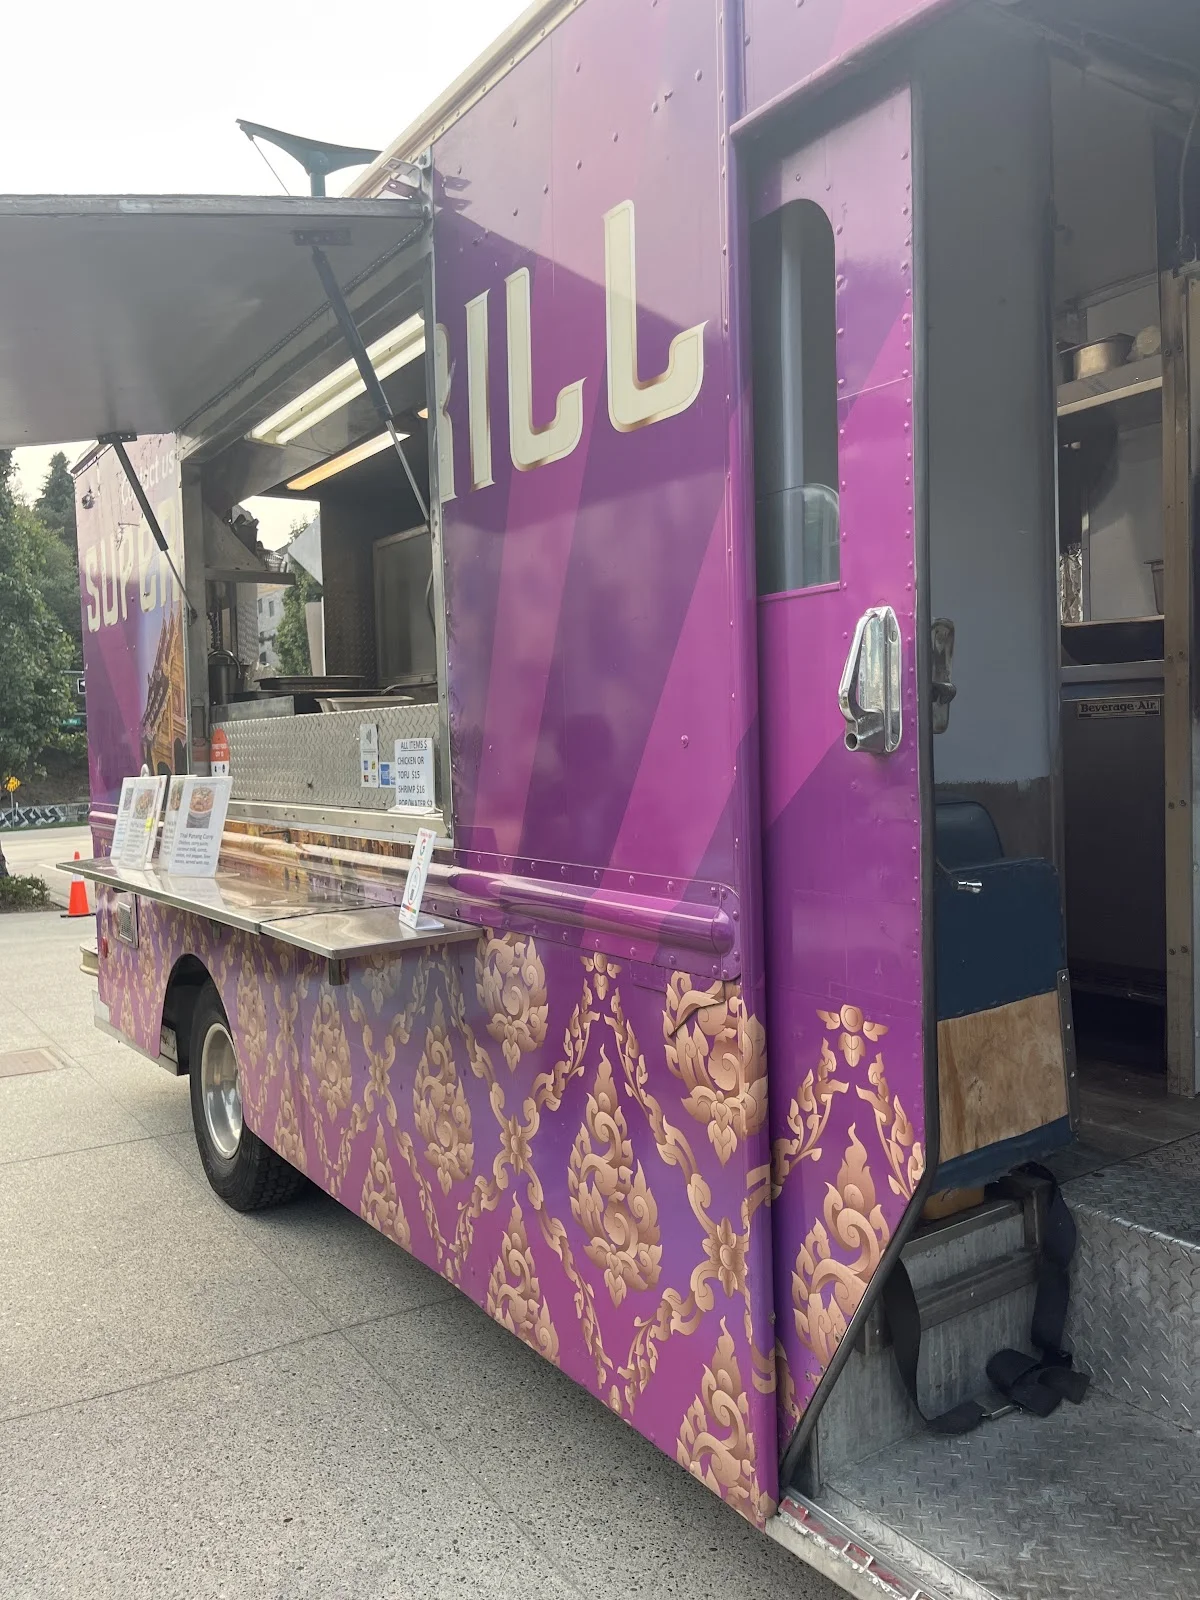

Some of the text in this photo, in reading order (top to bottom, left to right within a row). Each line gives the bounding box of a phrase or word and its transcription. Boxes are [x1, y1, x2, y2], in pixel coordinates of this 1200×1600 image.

[121, 449, 175, 505] Cotact us
[85, 499, 179, 633] SUPER
[409, 740, 423, 749] ITEMS
[397, 756, 424, 765] CHICKEN OR
[398, 770, 410, 779] TOFU
[411, 770, 420, 779] $15
[398, 785, 425, 794] SHRIMP $16
